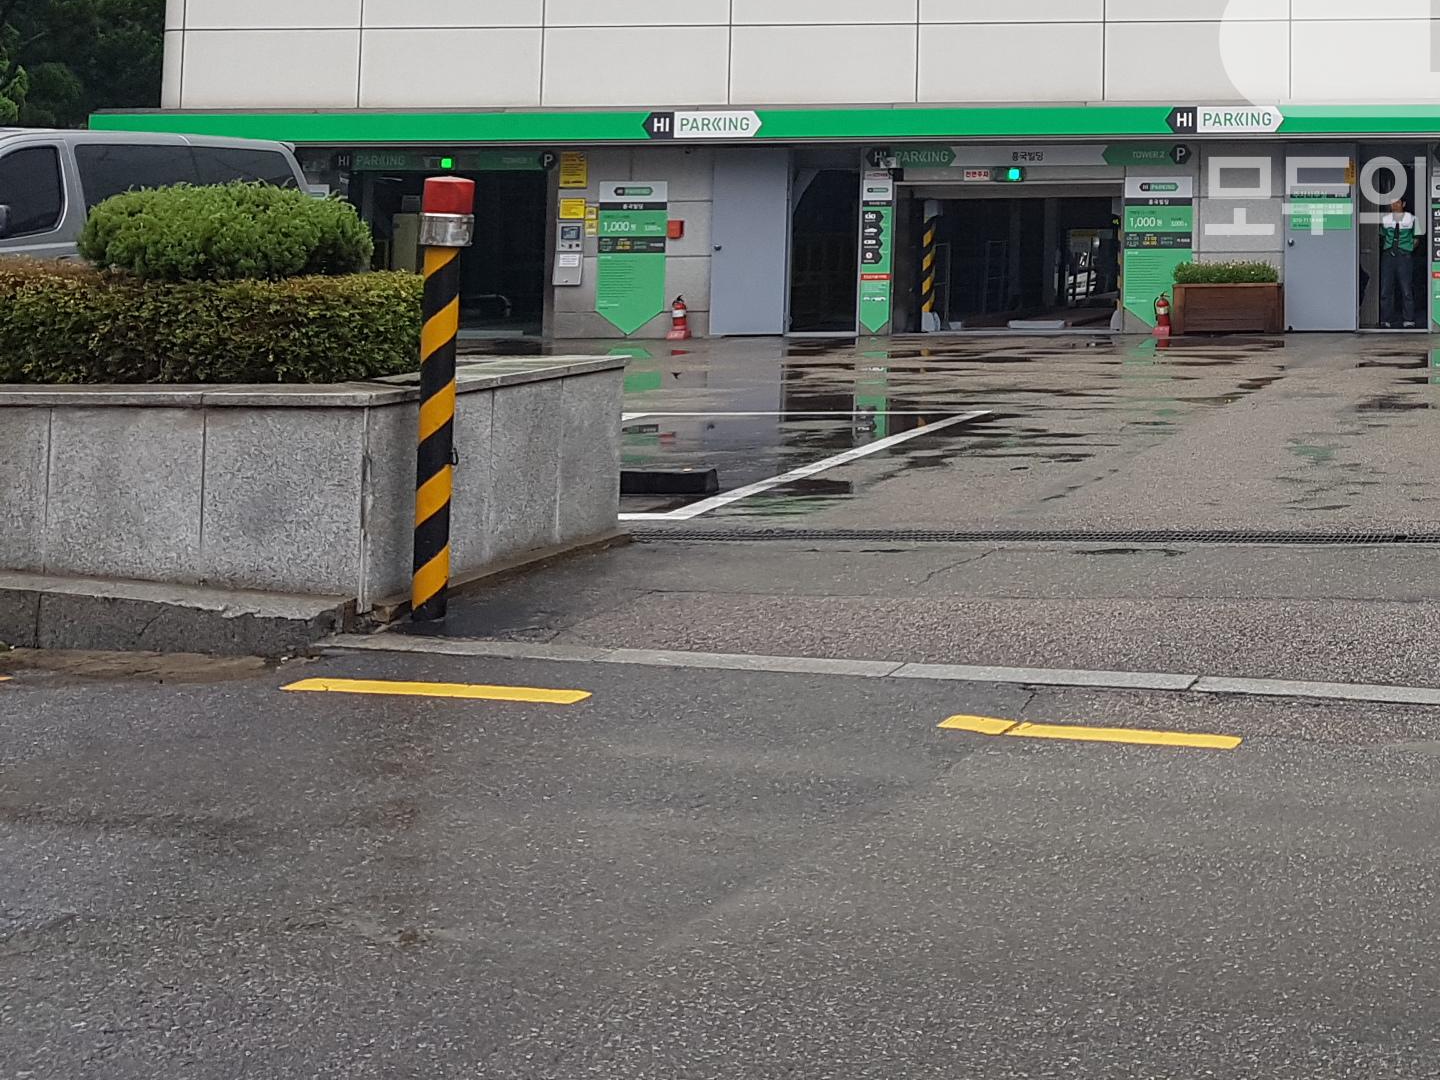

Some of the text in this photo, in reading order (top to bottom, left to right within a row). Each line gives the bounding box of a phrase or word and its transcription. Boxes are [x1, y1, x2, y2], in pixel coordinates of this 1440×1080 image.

[653, 117, 750, 132] HI PARKING
[1176, 112, 1272, 128] HI PARKING
[338, 155, 406, 167] HI PARKING
[543, 153, 553, 167] P
[896, 150, 949, 163] PARKING
[1011, 151, 1044, 162] 흥국빌딩
[1176, 147, 1186, 161] P
